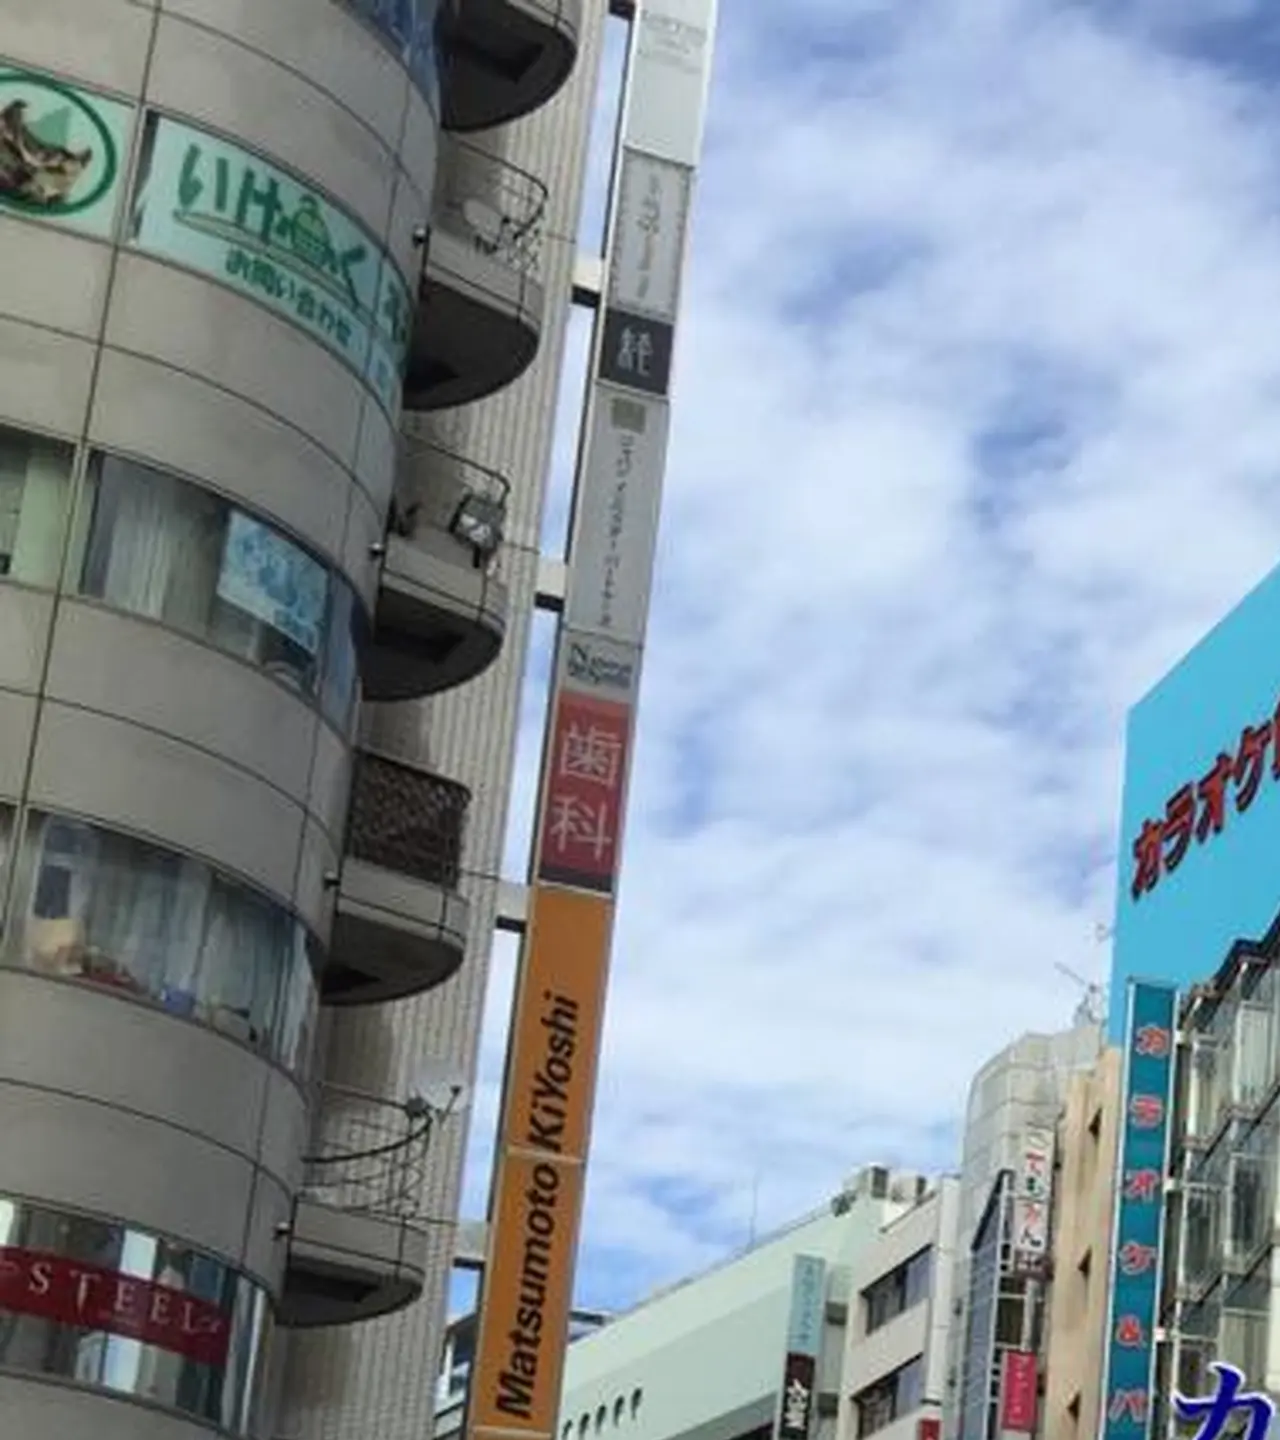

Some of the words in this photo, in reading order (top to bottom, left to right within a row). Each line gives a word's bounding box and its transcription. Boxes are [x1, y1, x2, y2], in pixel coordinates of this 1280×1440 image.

[550, 721, 623, 859] 歯科
[527, 990, 581, 1154] KiYoshi
[26, 1260, 200, 1334] STEEL
[495, 1161, 560, 1421] Matsumoto
